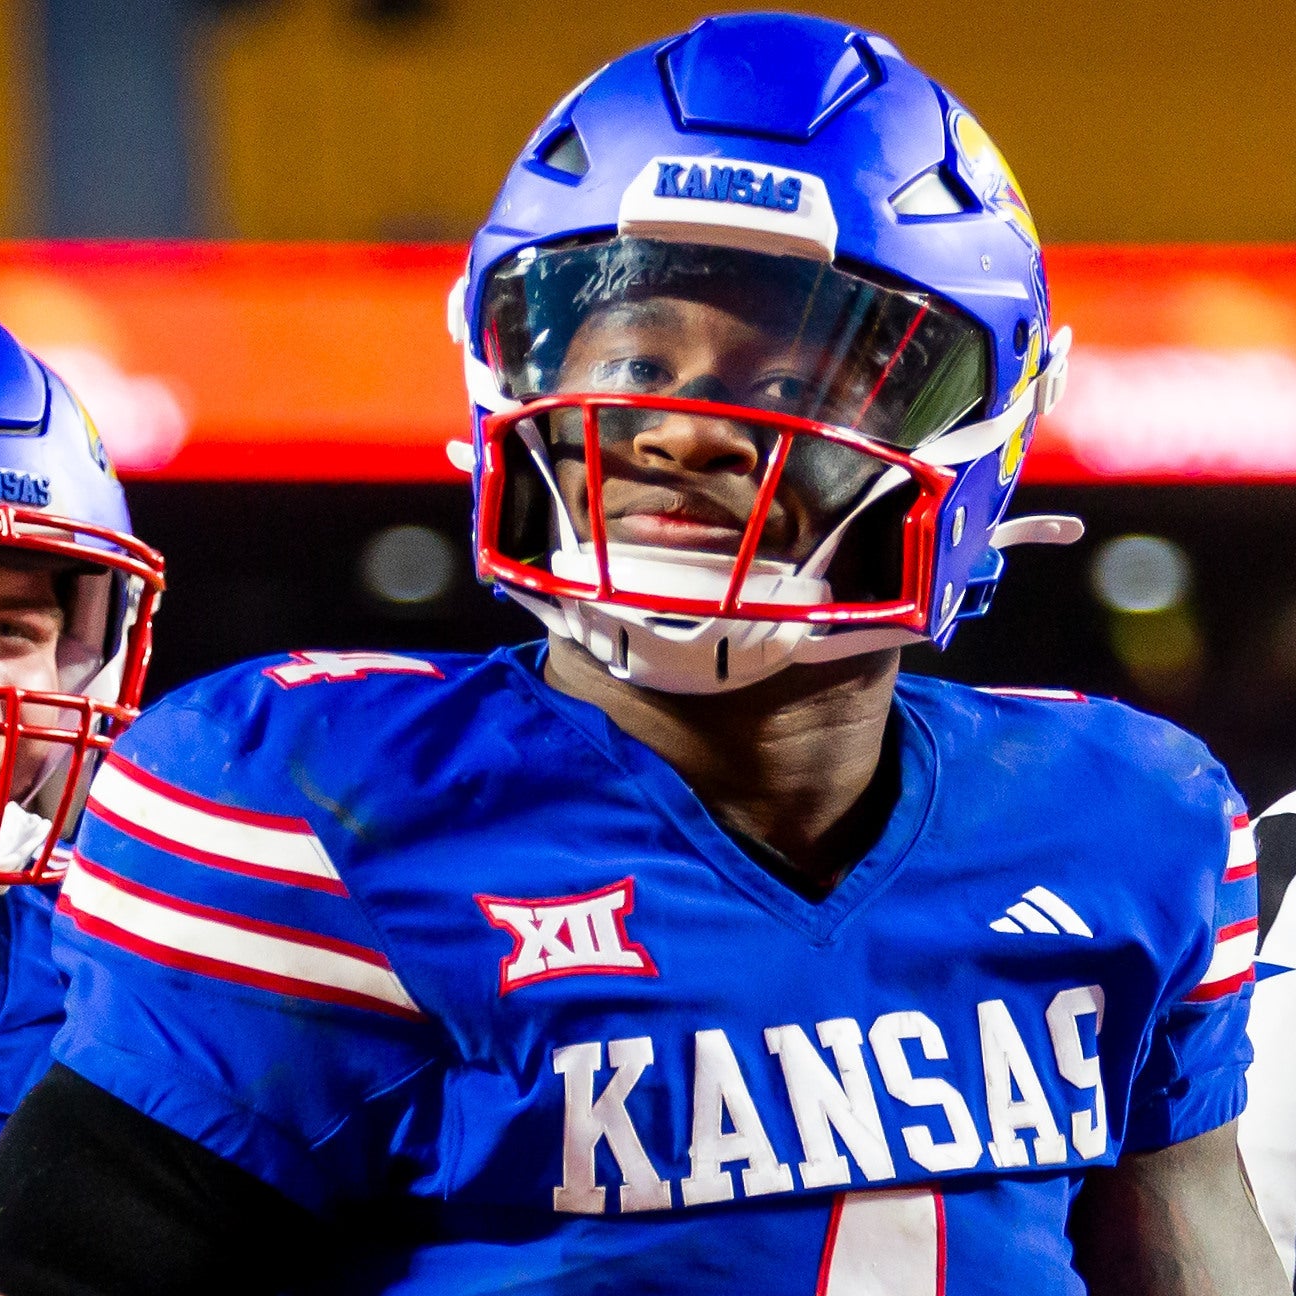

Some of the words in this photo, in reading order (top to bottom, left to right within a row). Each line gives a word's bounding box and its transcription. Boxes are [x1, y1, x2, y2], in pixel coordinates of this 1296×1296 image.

[653, 161, 803, 214] KANSAS
[483, 886, 651, 988] XII
[552, 984, 1108, 1214] KANSAS
